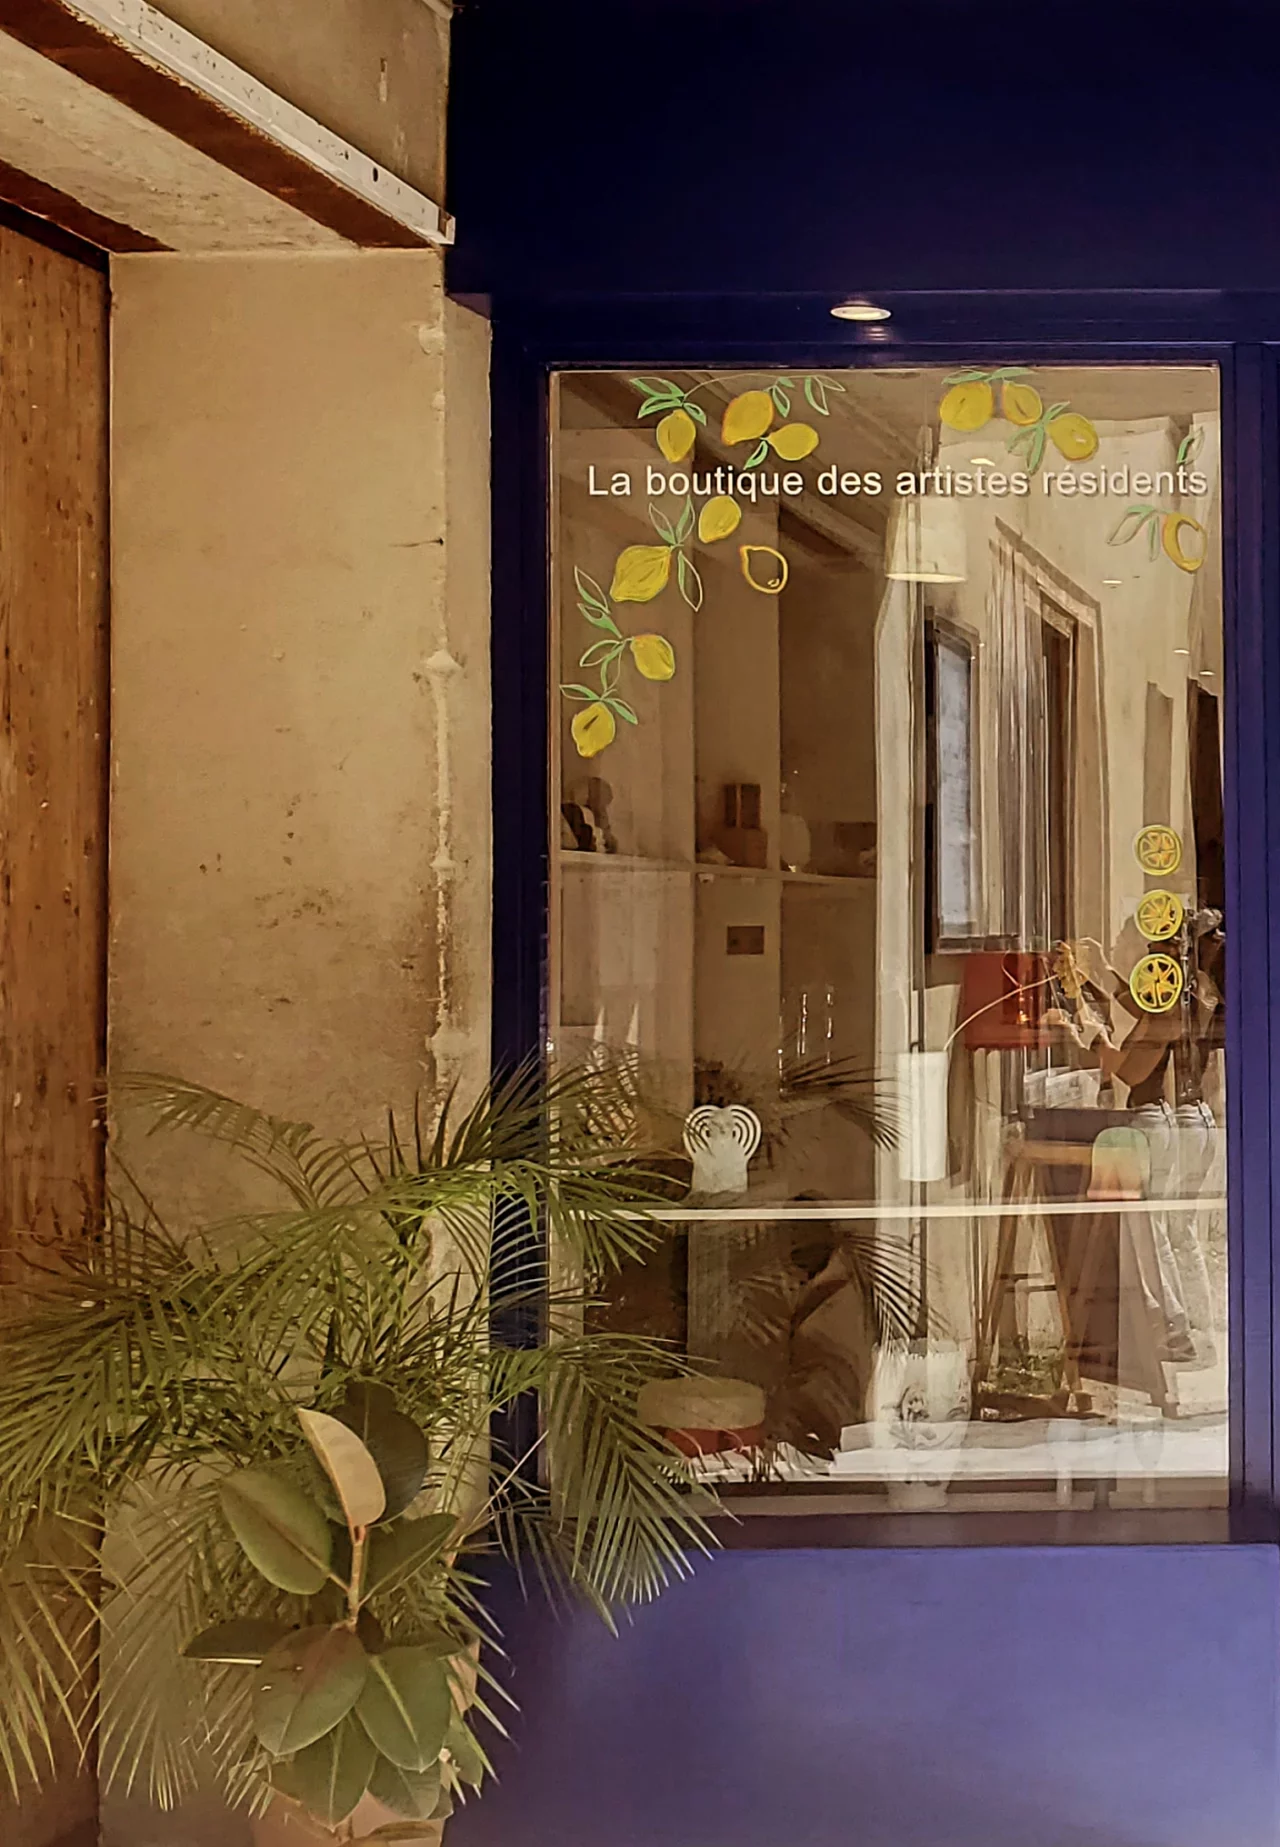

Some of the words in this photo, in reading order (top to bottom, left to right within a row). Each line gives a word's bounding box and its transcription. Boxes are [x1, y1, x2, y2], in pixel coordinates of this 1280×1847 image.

[588, 465, 631, 496] La
[646, 464, 804, 502] boutique
[816, 465, 883, 496] des
[895, 464, 1029, 496] artistes
[1042, 464, 1208, 496] résidents
